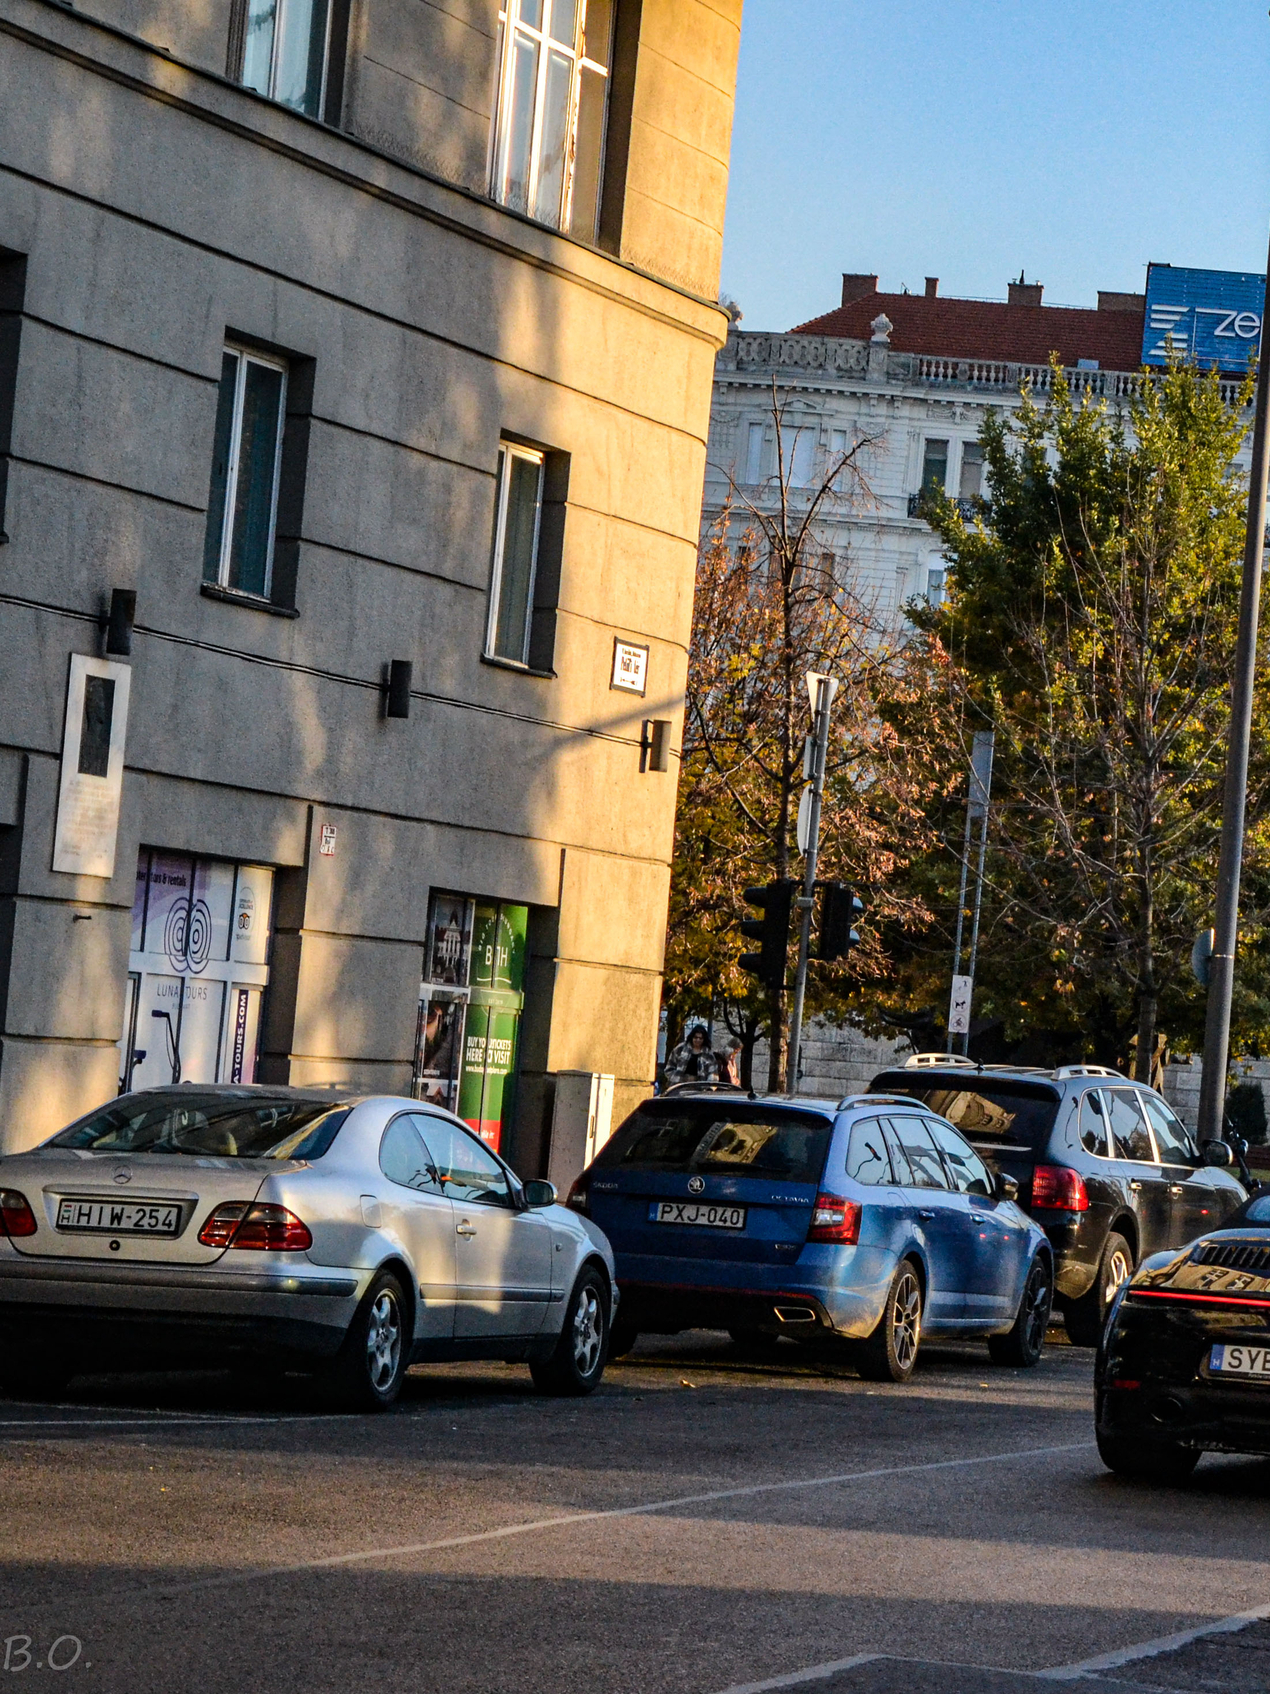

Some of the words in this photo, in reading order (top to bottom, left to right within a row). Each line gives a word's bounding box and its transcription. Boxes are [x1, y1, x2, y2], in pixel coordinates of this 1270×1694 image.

[156, 984, 179, 998] LUNA
[466, 1047, 483, 1062] HERE
[494, 1050, 511, 1064] VISIT
[76, 1204, 173, 1229] HIW-254
[660, 1203, 740, 1226] PXJ-040
